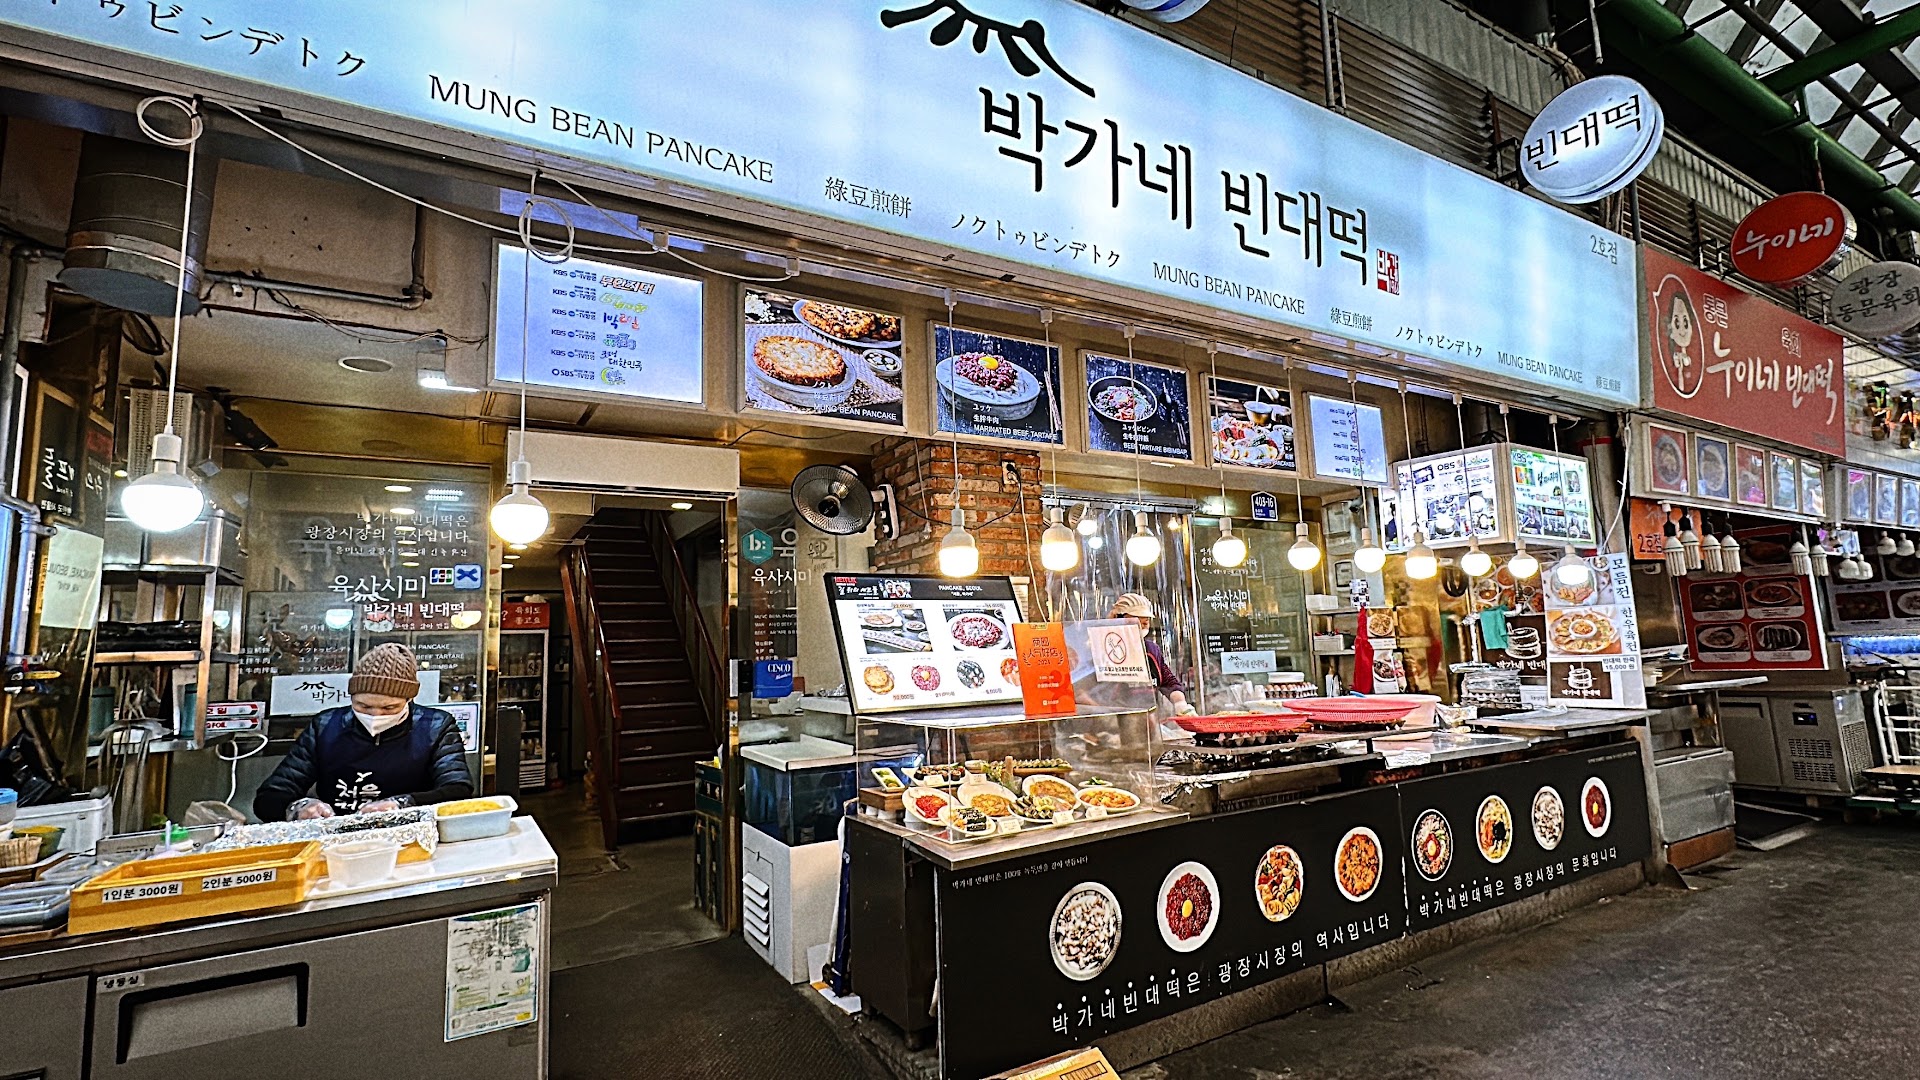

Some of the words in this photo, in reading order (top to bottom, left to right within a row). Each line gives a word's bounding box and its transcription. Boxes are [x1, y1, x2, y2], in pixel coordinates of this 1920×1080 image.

[51, 0, 366, 77] ゥビンデトク
[429, 75, 537, 124] MUNG
[550, 106, 634, 149] BEAN
[646, 131, 774, 184] PANCAKE
[1525, 94, 1641, 171] 빈대떡
[824, 176, 912, 218] 綠豆煎餅
[979, 86, 1193, 230] 박가네
[1221, 169, 1369, 286] 빈대떡
[1590, 234, 1618, 265] 2호점
[1153, 261, 1200, 291] MUNG
[1204, 274, 1242, 302] BEAN
[1246, 285, 1305, 315] PANCAKE
[1498, 351, 1524, 370] MUNG
[1526, 358, 1547, 375] BEAN
[1549, 364, 1583, 384] PANCAKE
[1785, 358, 1838, 426] 빈대떡
[814, 404, 837, 414] MUNG
[840, 407, 860, 416] BEAN
[862, 409, 897, 420] PANCAKE
[973, 403, 992, 412] ユッケ
[973, 424, 1012, 435] MARINATED
[1255, 496, 1273, 507] 403-16
[411, 514, 469, 528] 빈대떡은
[305, 526, 385, 541] 광장시장의
[328, 575, 426, 599] 육사시미
[751, 568, 811, 587] 육사시미
[1612, 558, 1631, 599] 모듬전
[364, 603, 413, 618] 박가네
[420, 602, 465, 618] 빈대떡
[767, 664, 791, 673] CESCO
[1528, 659, 1548, 671] 빈대
[203, 876, 233, 889] 2인분
[236, 870, 273, 884] 5000원
[1514, 861, 1566, 891] 광장시장의
[1572, 847, 1618, 872] 문화입니다
[103, 888, 135, 900] 1인분
[139, 883, 179, 897] 3000원
[1218, 939, 1303, 983] 광장시장의
[1316, 912, 1390, 948] 역사입니다
